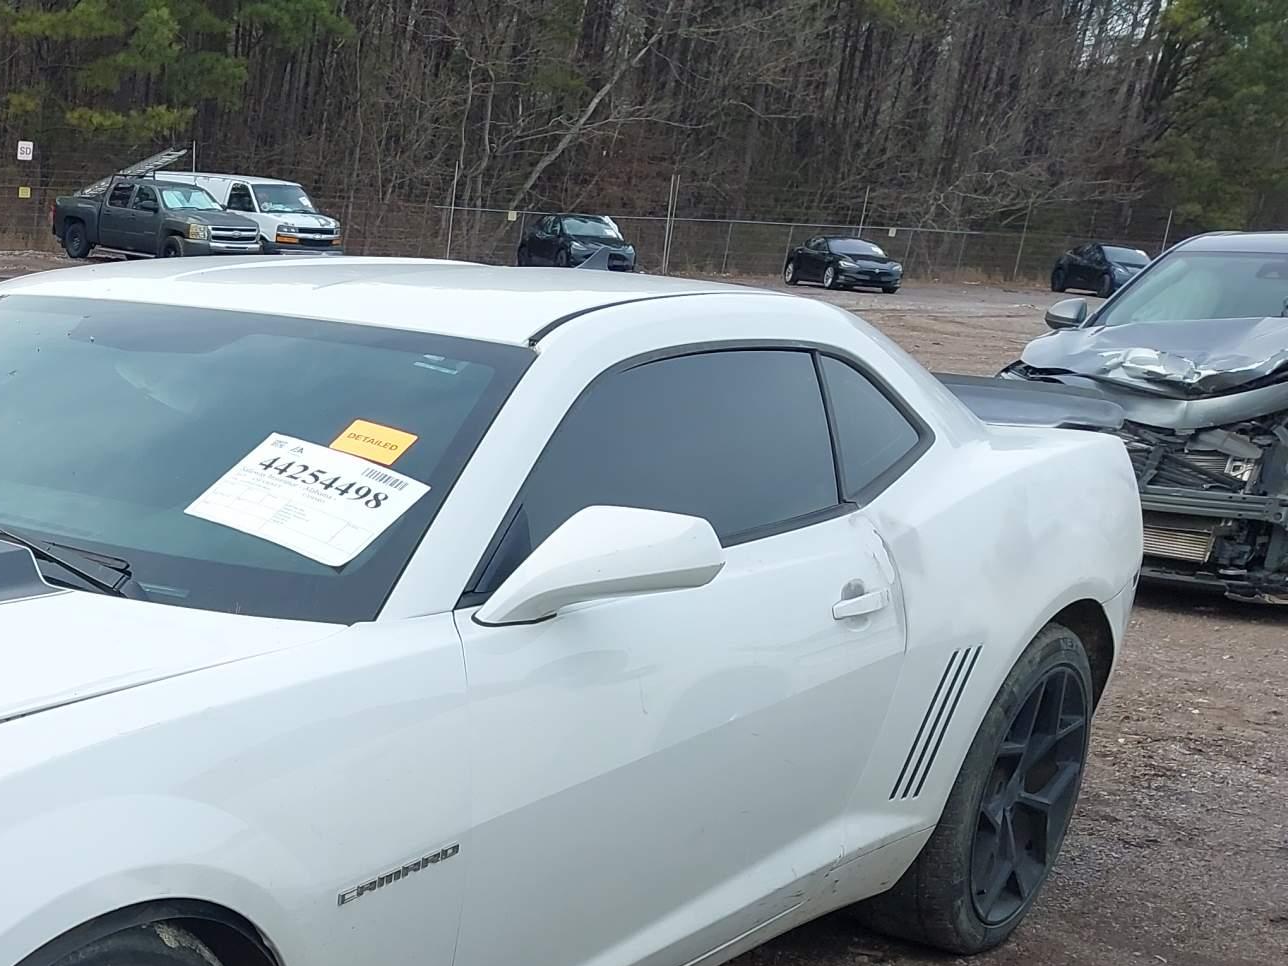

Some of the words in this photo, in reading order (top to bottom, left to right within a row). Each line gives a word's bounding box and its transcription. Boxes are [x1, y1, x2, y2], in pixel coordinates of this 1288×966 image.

[19, 147, 32, 156] SD
[347, 432, 399, 451] DETAILED
[259, 456, 389, 509] 44254498
[337, 841, 460, 906] CAMARO
